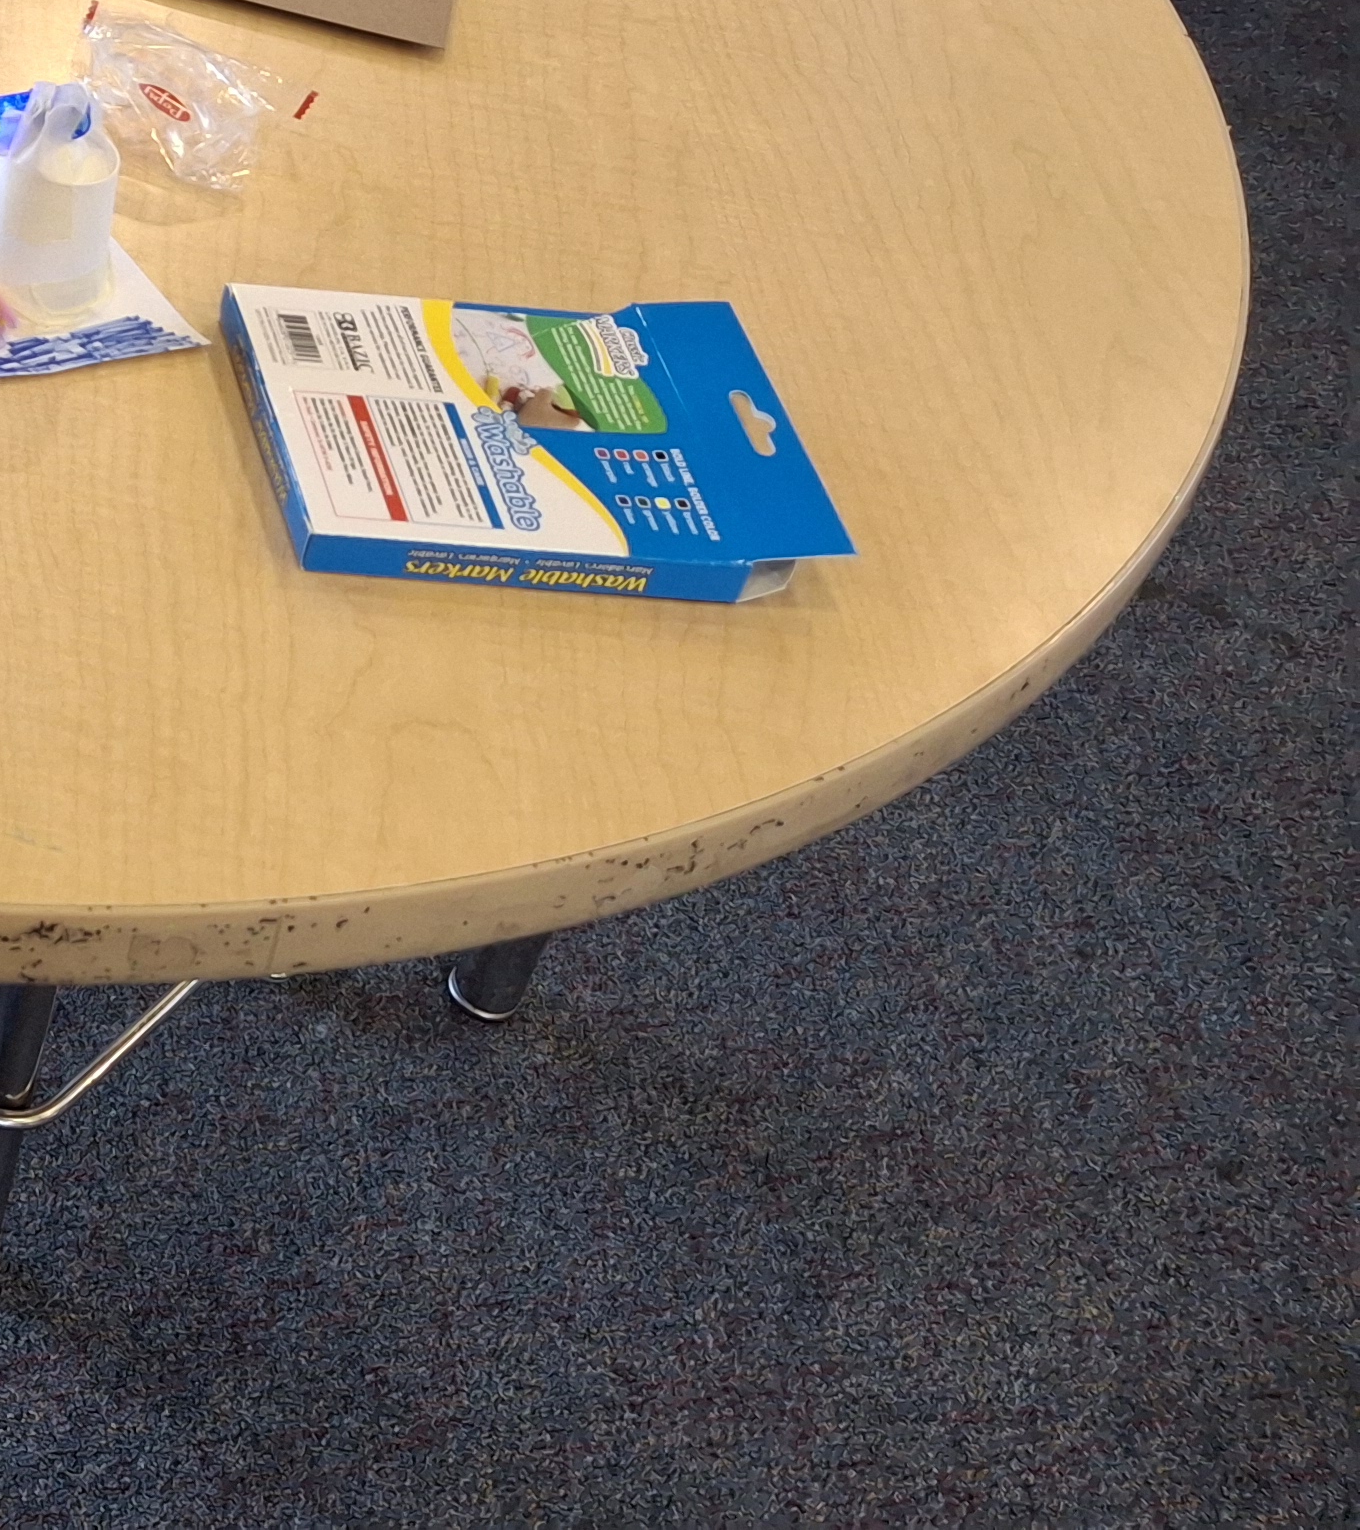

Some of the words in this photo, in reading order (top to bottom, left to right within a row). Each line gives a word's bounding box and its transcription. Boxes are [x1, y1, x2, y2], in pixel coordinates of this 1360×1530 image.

[350, 334, 372, 371] BAZIC
[398, 305, 426, 352] PERFORMANCE
[419, 354, 443, 393] GUARANTEE
[592, 317, 635, 375] MARKERS
[476, 424, 541, 530] Washable
[699, 516, 721, 540] COLOR
[405, 561, 513, 583] Markers
[519, 569, 647, 593] Washable
